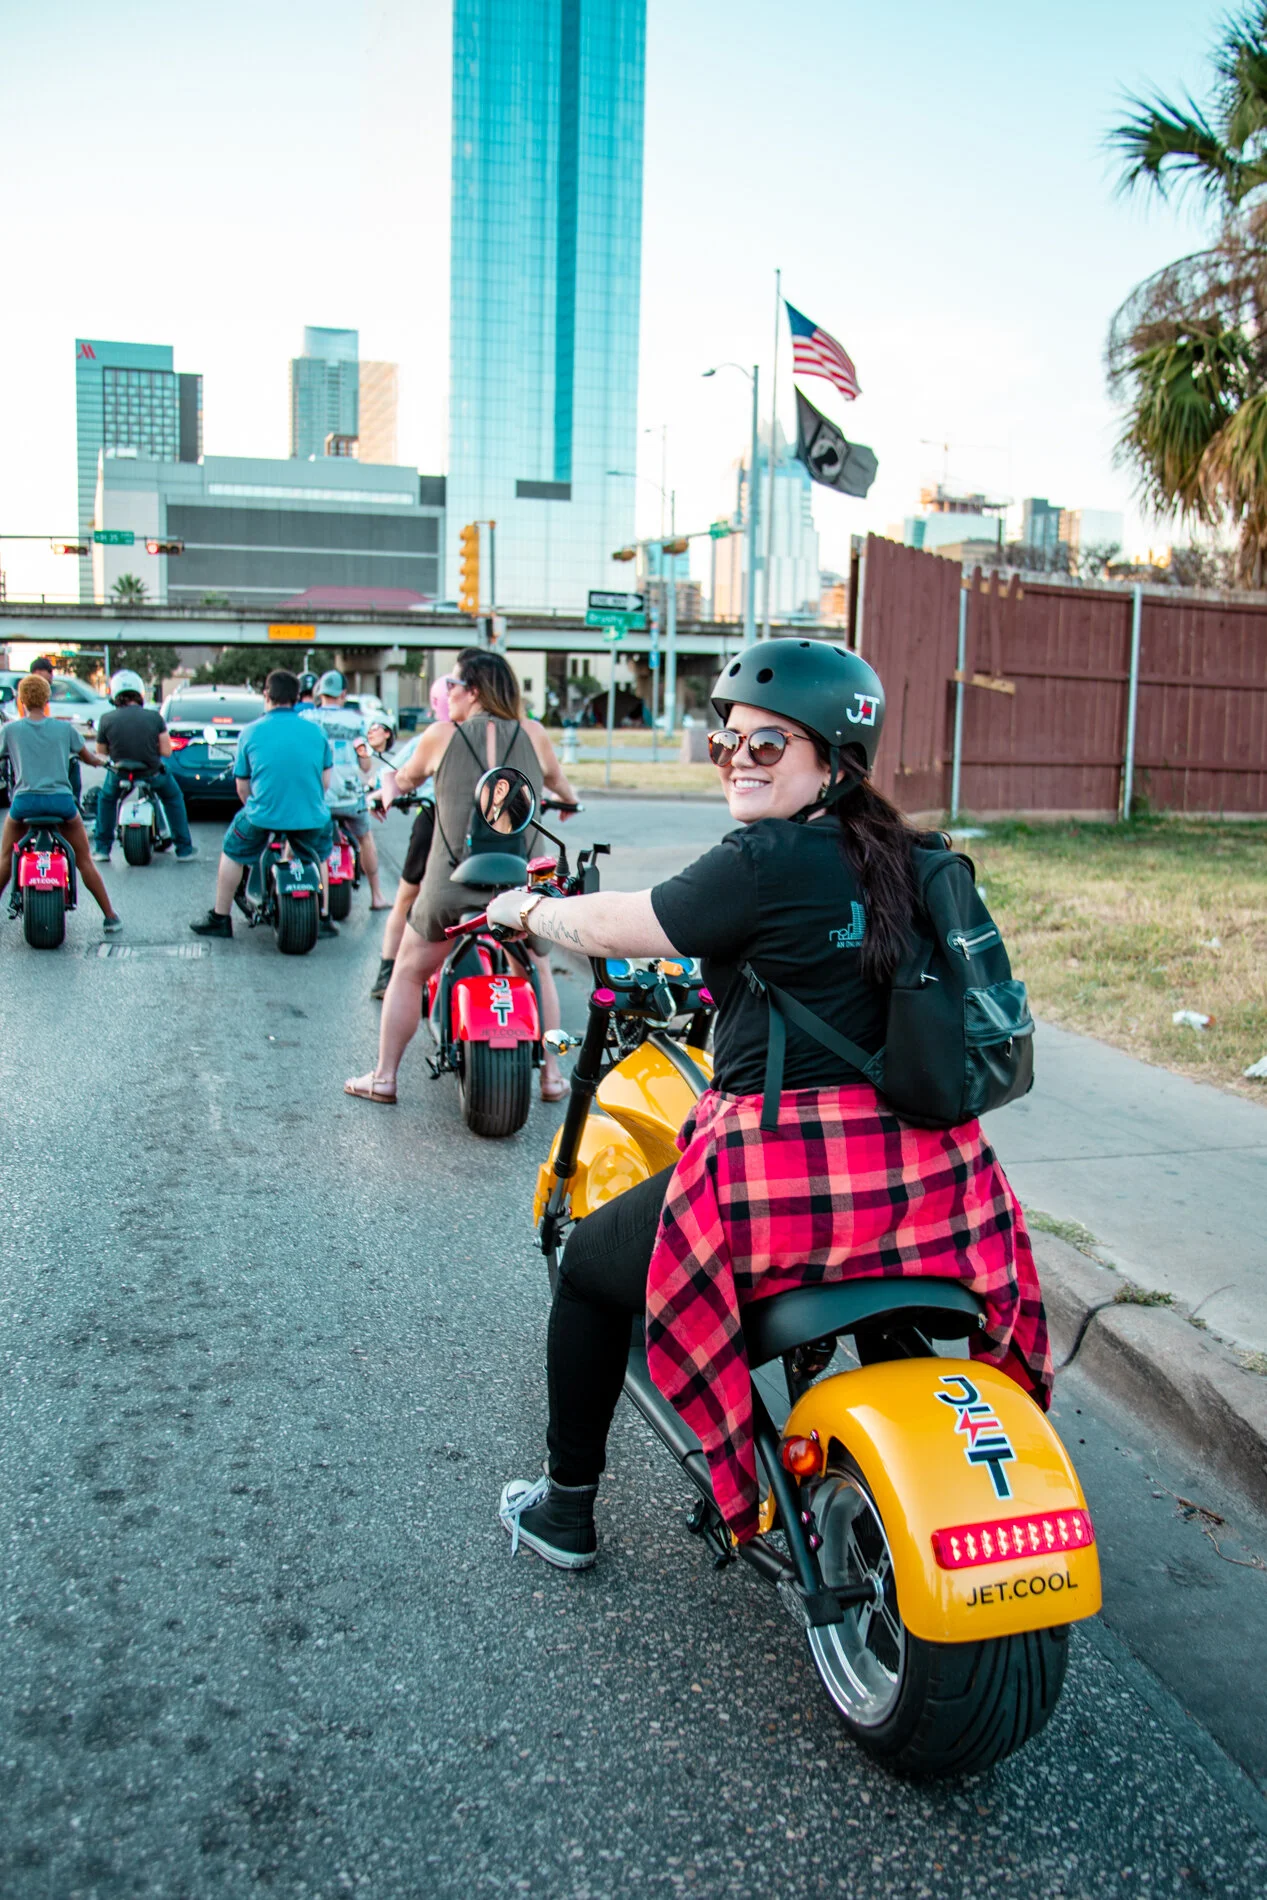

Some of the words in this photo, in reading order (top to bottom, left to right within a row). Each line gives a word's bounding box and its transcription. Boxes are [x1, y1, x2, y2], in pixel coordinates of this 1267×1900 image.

[489, 978, 514, 1027] JET
[933, 1374, 1017, 1501] JET
[966, 1570, 1079, 1607] JET.COOL
